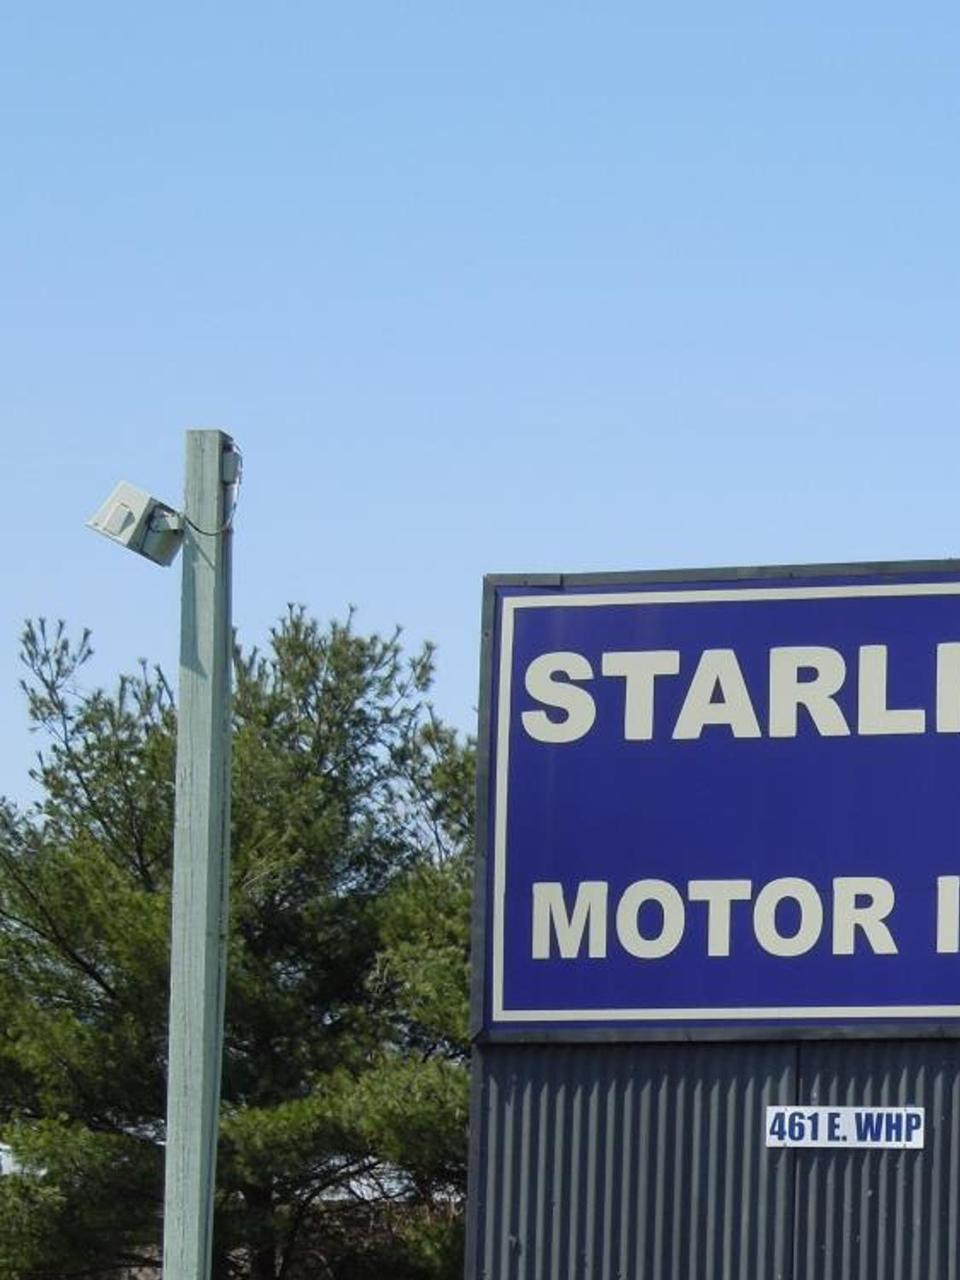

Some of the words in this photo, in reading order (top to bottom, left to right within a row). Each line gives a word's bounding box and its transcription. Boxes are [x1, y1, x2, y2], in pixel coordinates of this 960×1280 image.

[531, 876, 899, 960] MOTOR
[769, 1111, 819, 1142] 461
[827, 1112, 848, 1142] E.
[854, 1112, 922, 1143] WHP
